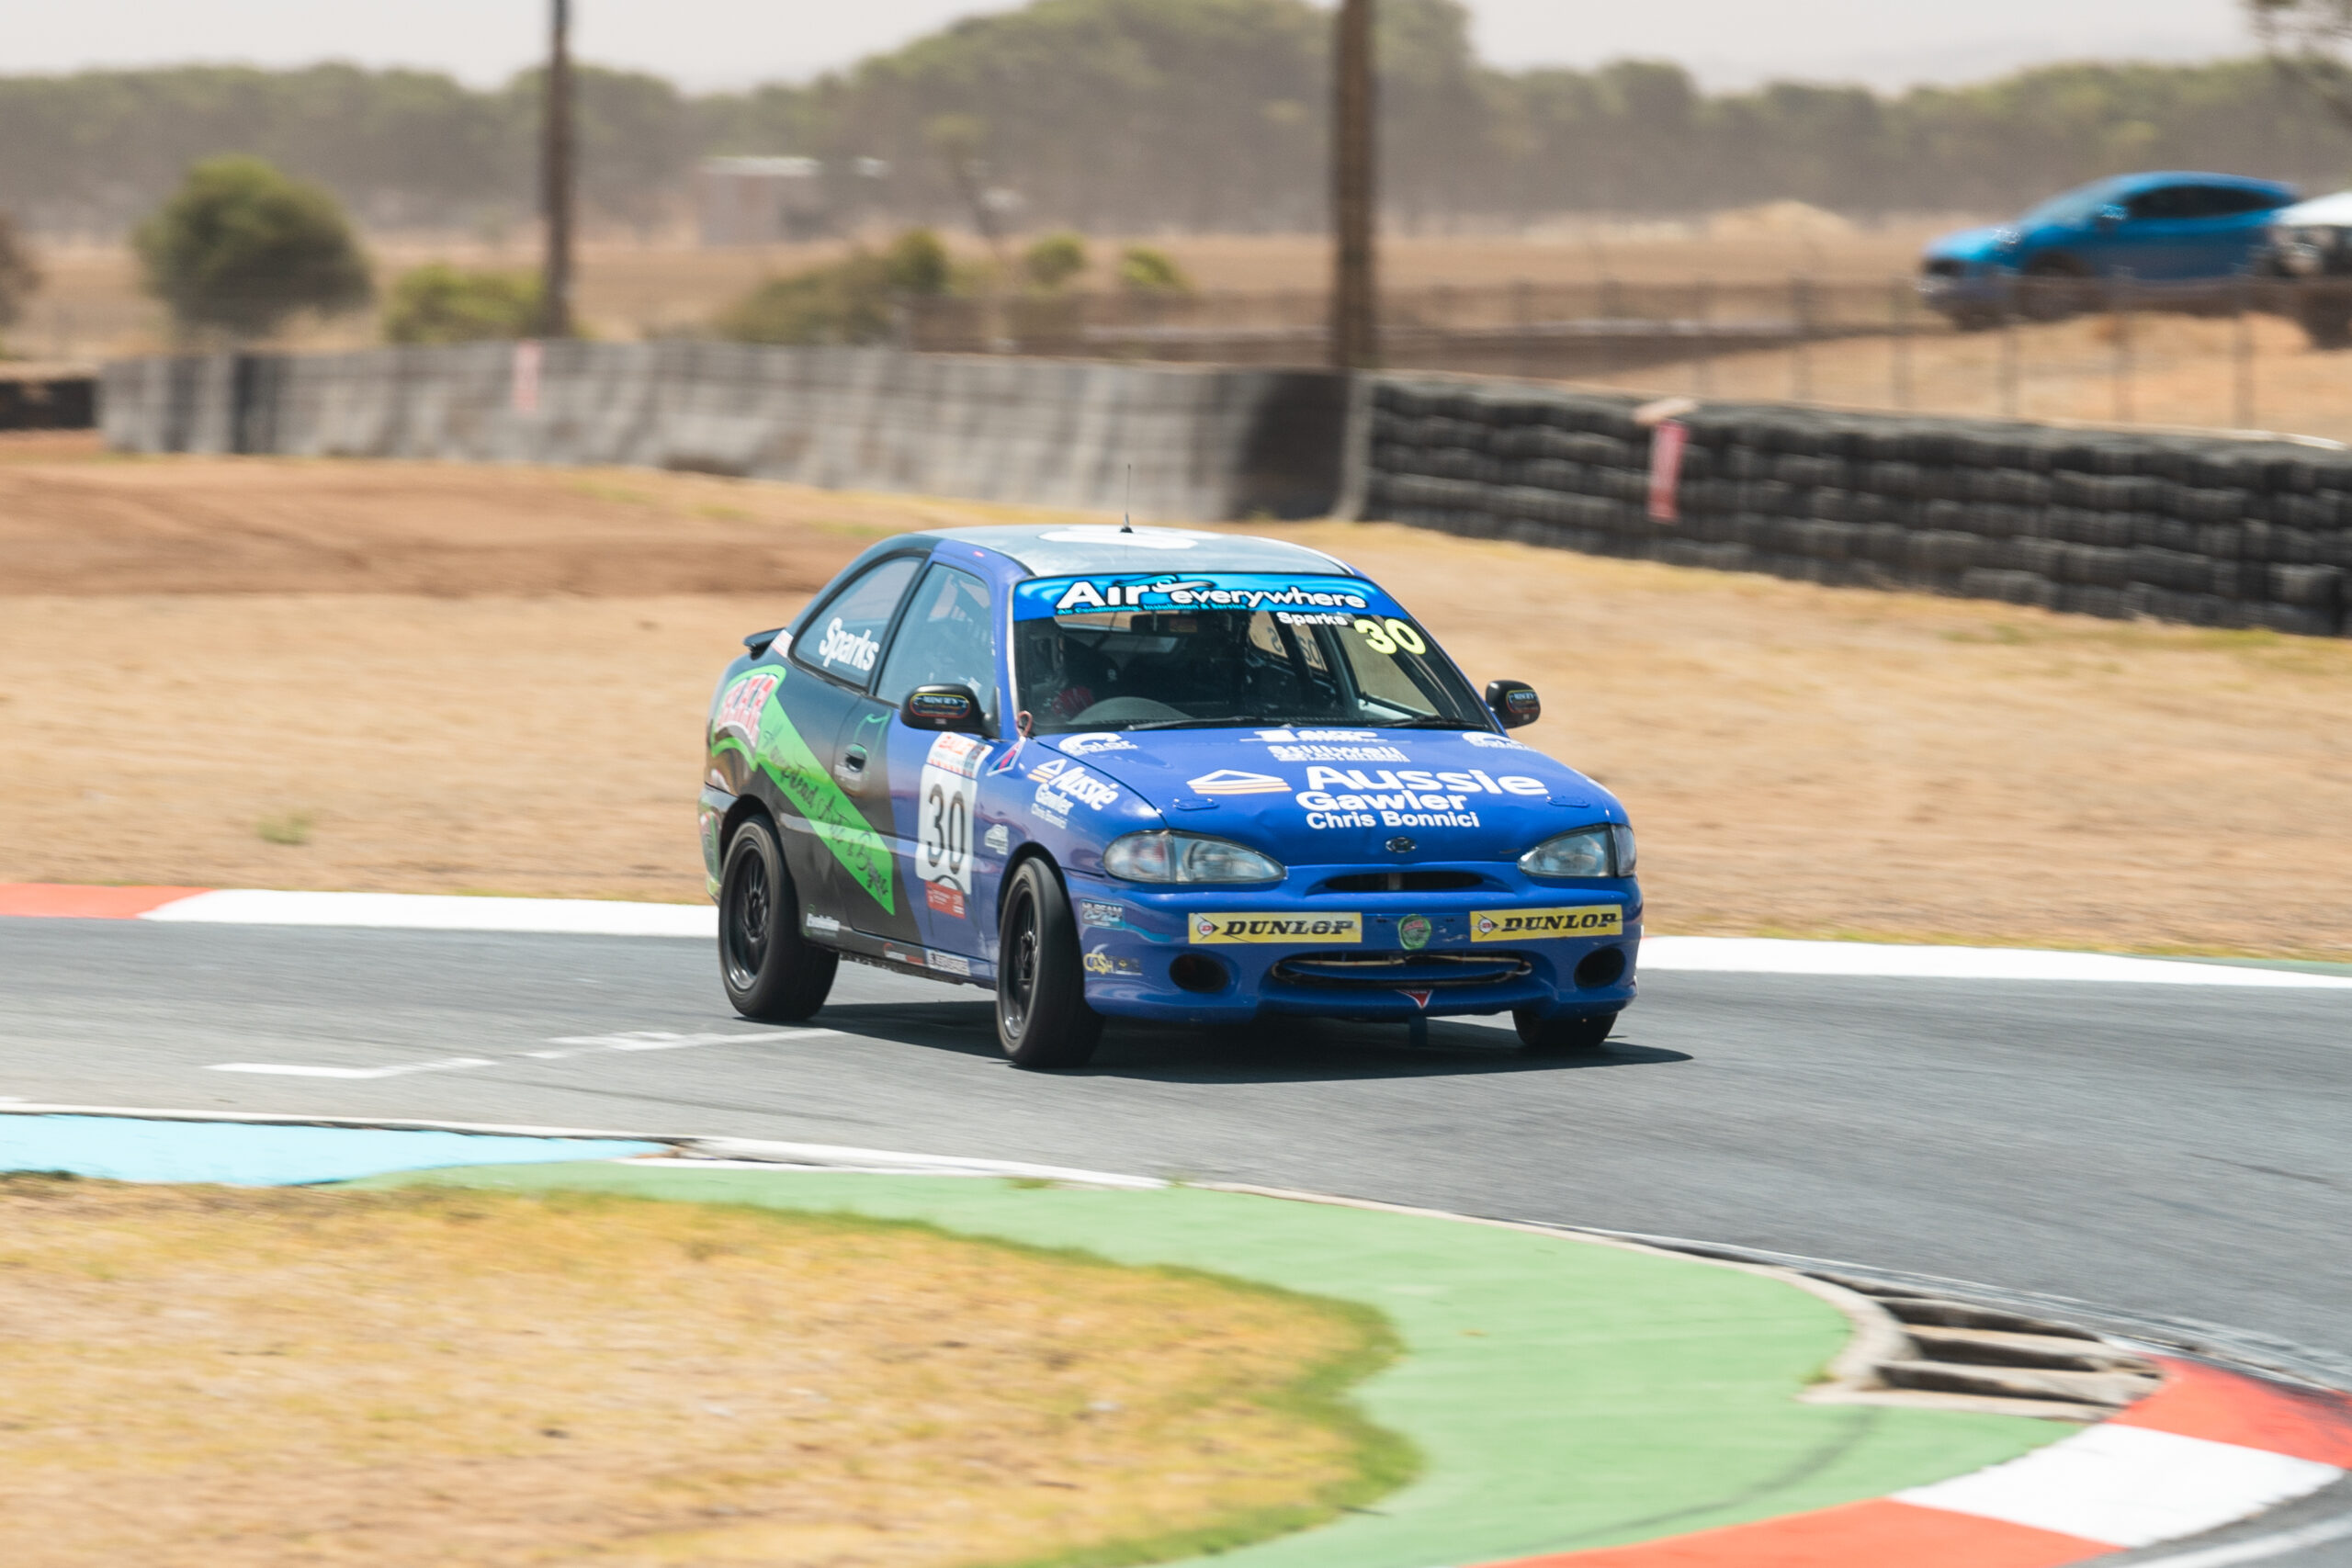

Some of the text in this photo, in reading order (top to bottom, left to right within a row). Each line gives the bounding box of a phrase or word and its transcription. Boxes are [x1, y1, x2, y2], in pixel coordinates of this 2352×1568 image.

[1056, 581, 1367, 609] Air everywhere
[1276, 612, 1348, 626] Sparks
[819, 617, 879, 671] Sparks
[1353, 618, 1426, 654] 30
[1048, 766, 1119, 811] Aussie
[1306, 765, 1550, 795] Aussie
[1295, 790, 1468, 812] Gawler
[928, 784, 966, 874] 30
[1306, 810, 1480, 829] Chris Bonnici
[1224, 920, 1353, 935] DUNLOP
[1501, 913, 1617, 932] DUNLOP
